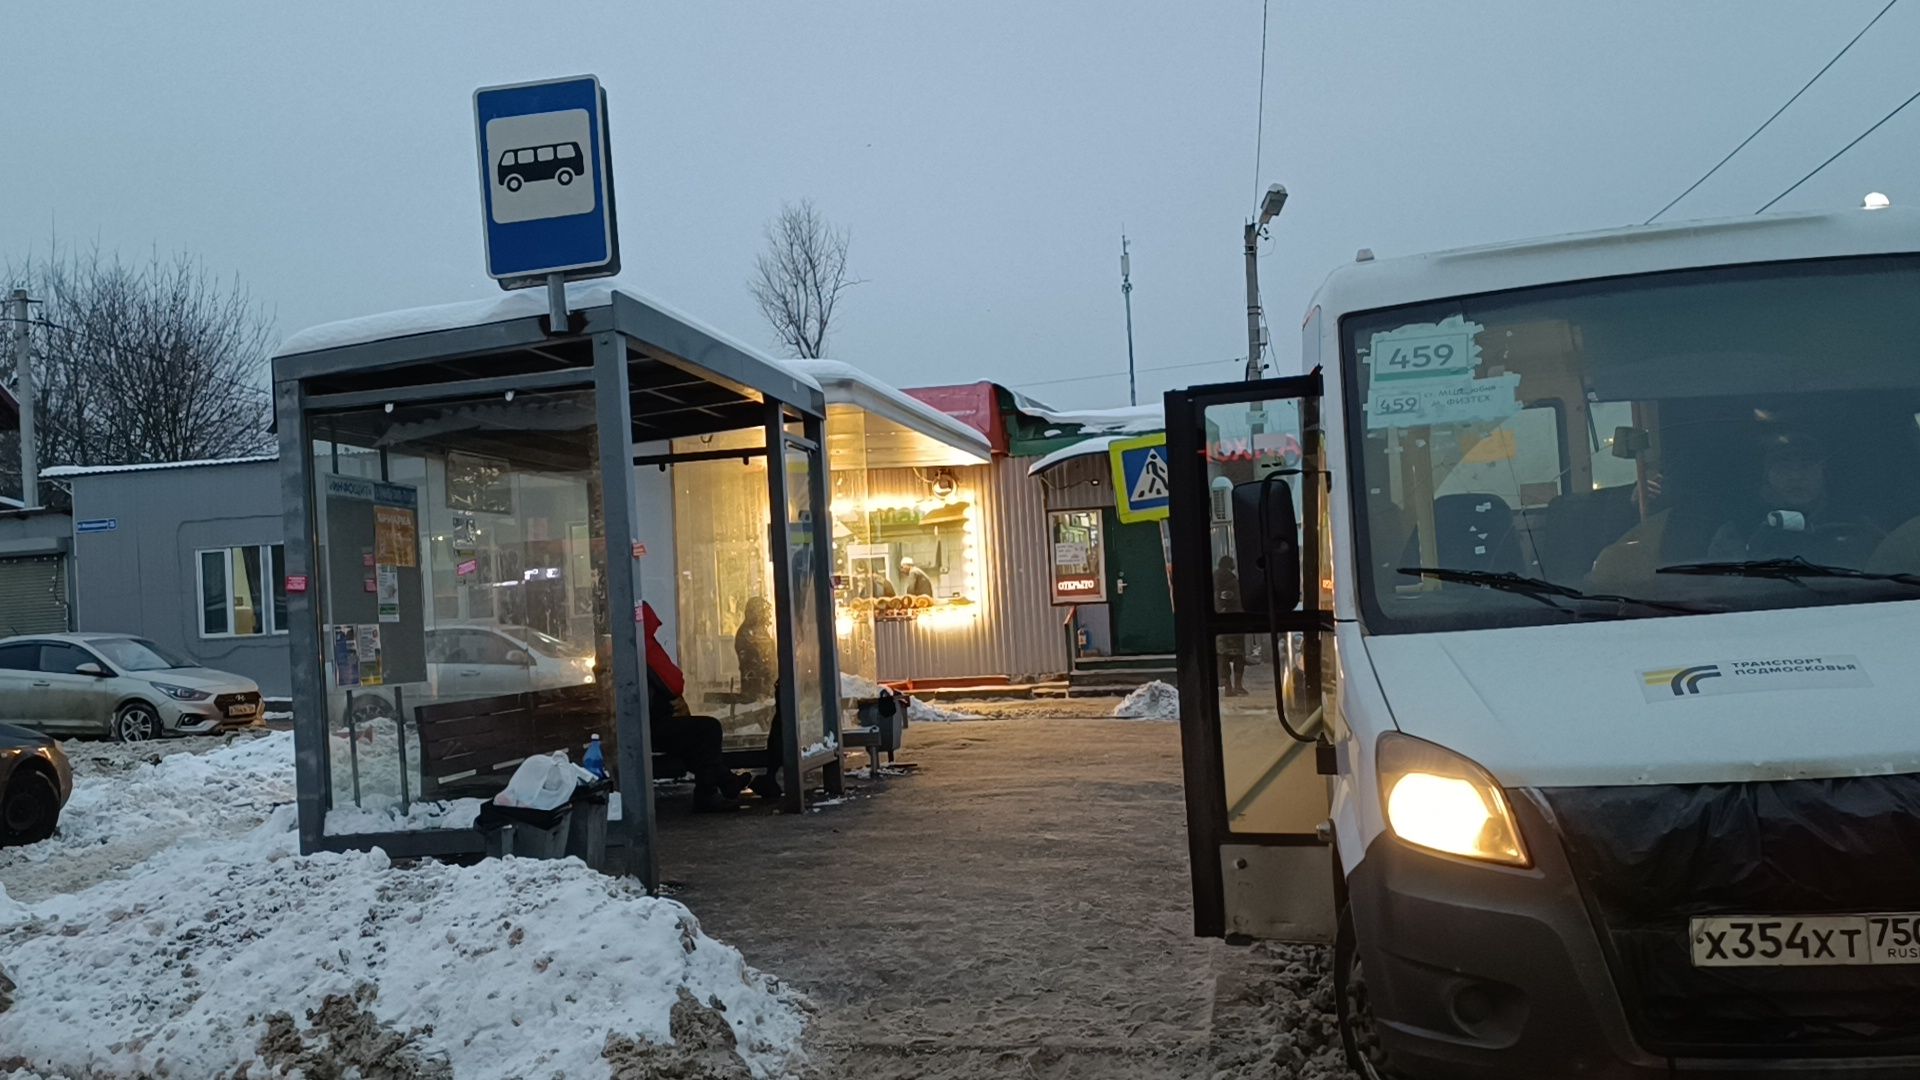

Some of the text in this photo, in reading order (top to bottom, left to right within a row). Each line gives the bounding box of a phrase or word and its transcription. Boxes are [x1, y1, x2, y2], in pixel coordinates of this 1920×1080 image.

[1389, 343, 1455, 369] 459
[1380, 397, 1417, 412] 459
[1447, 395, 1491, 406] ФИЗТЕХ
[1058, 580, 1094, 591] ОТКРЫТО
[1731, 657, 1823, 668] ТРАНСПОРТ
[1735, 663, 1857, 676] ПОДМОСКОВЬЯ
[1704, 921, 1862, 960] Х354ХТ
